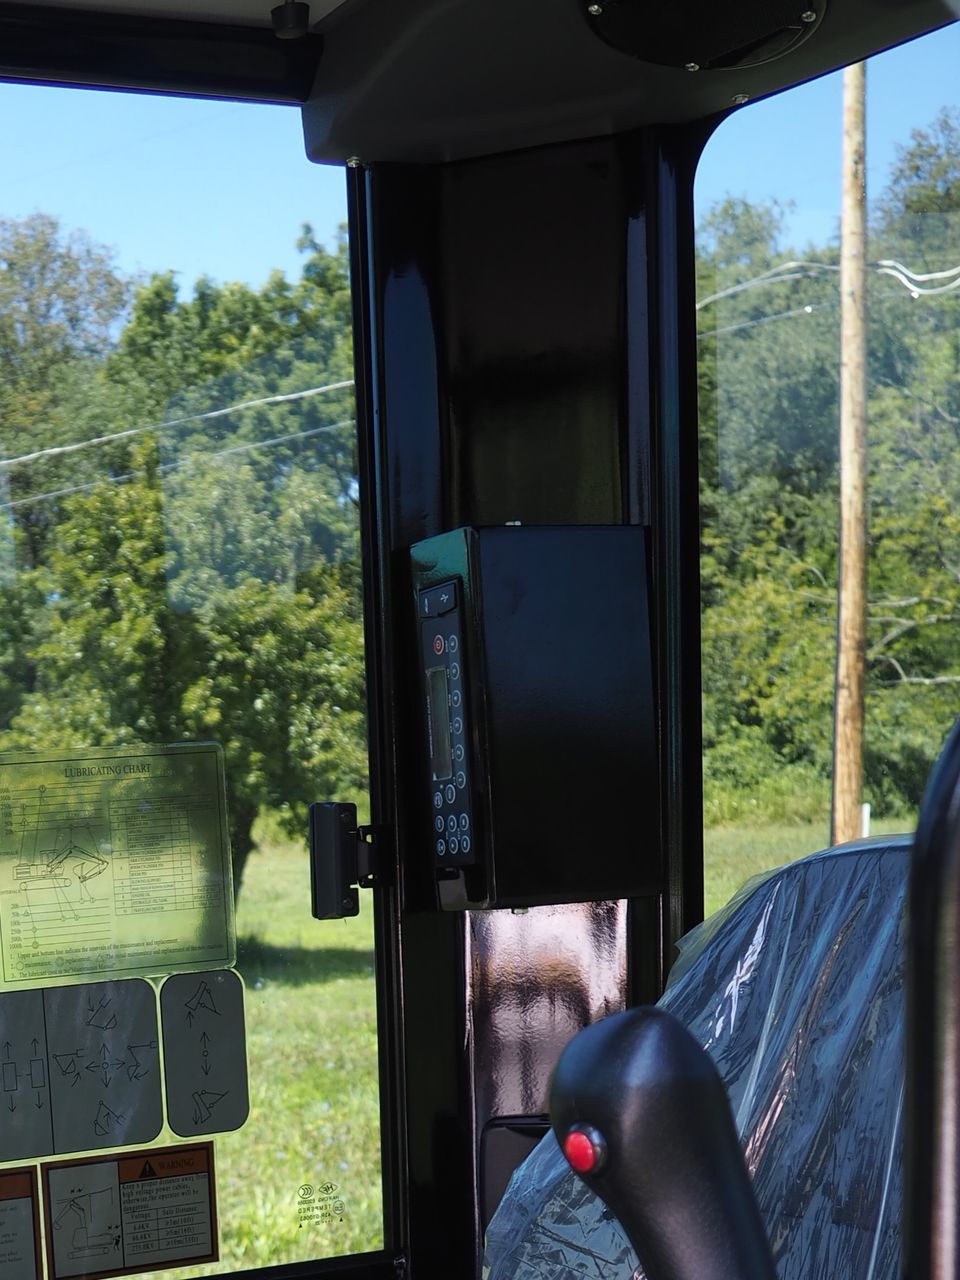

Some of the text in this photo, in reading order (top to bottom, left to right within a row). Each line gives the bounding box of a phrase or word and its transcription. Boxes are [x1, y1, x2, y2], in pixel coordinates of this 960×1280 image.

[64, 764, 152, 777] LUBRICATING CHART
[159, 1159, 194, 1168] WARNING
